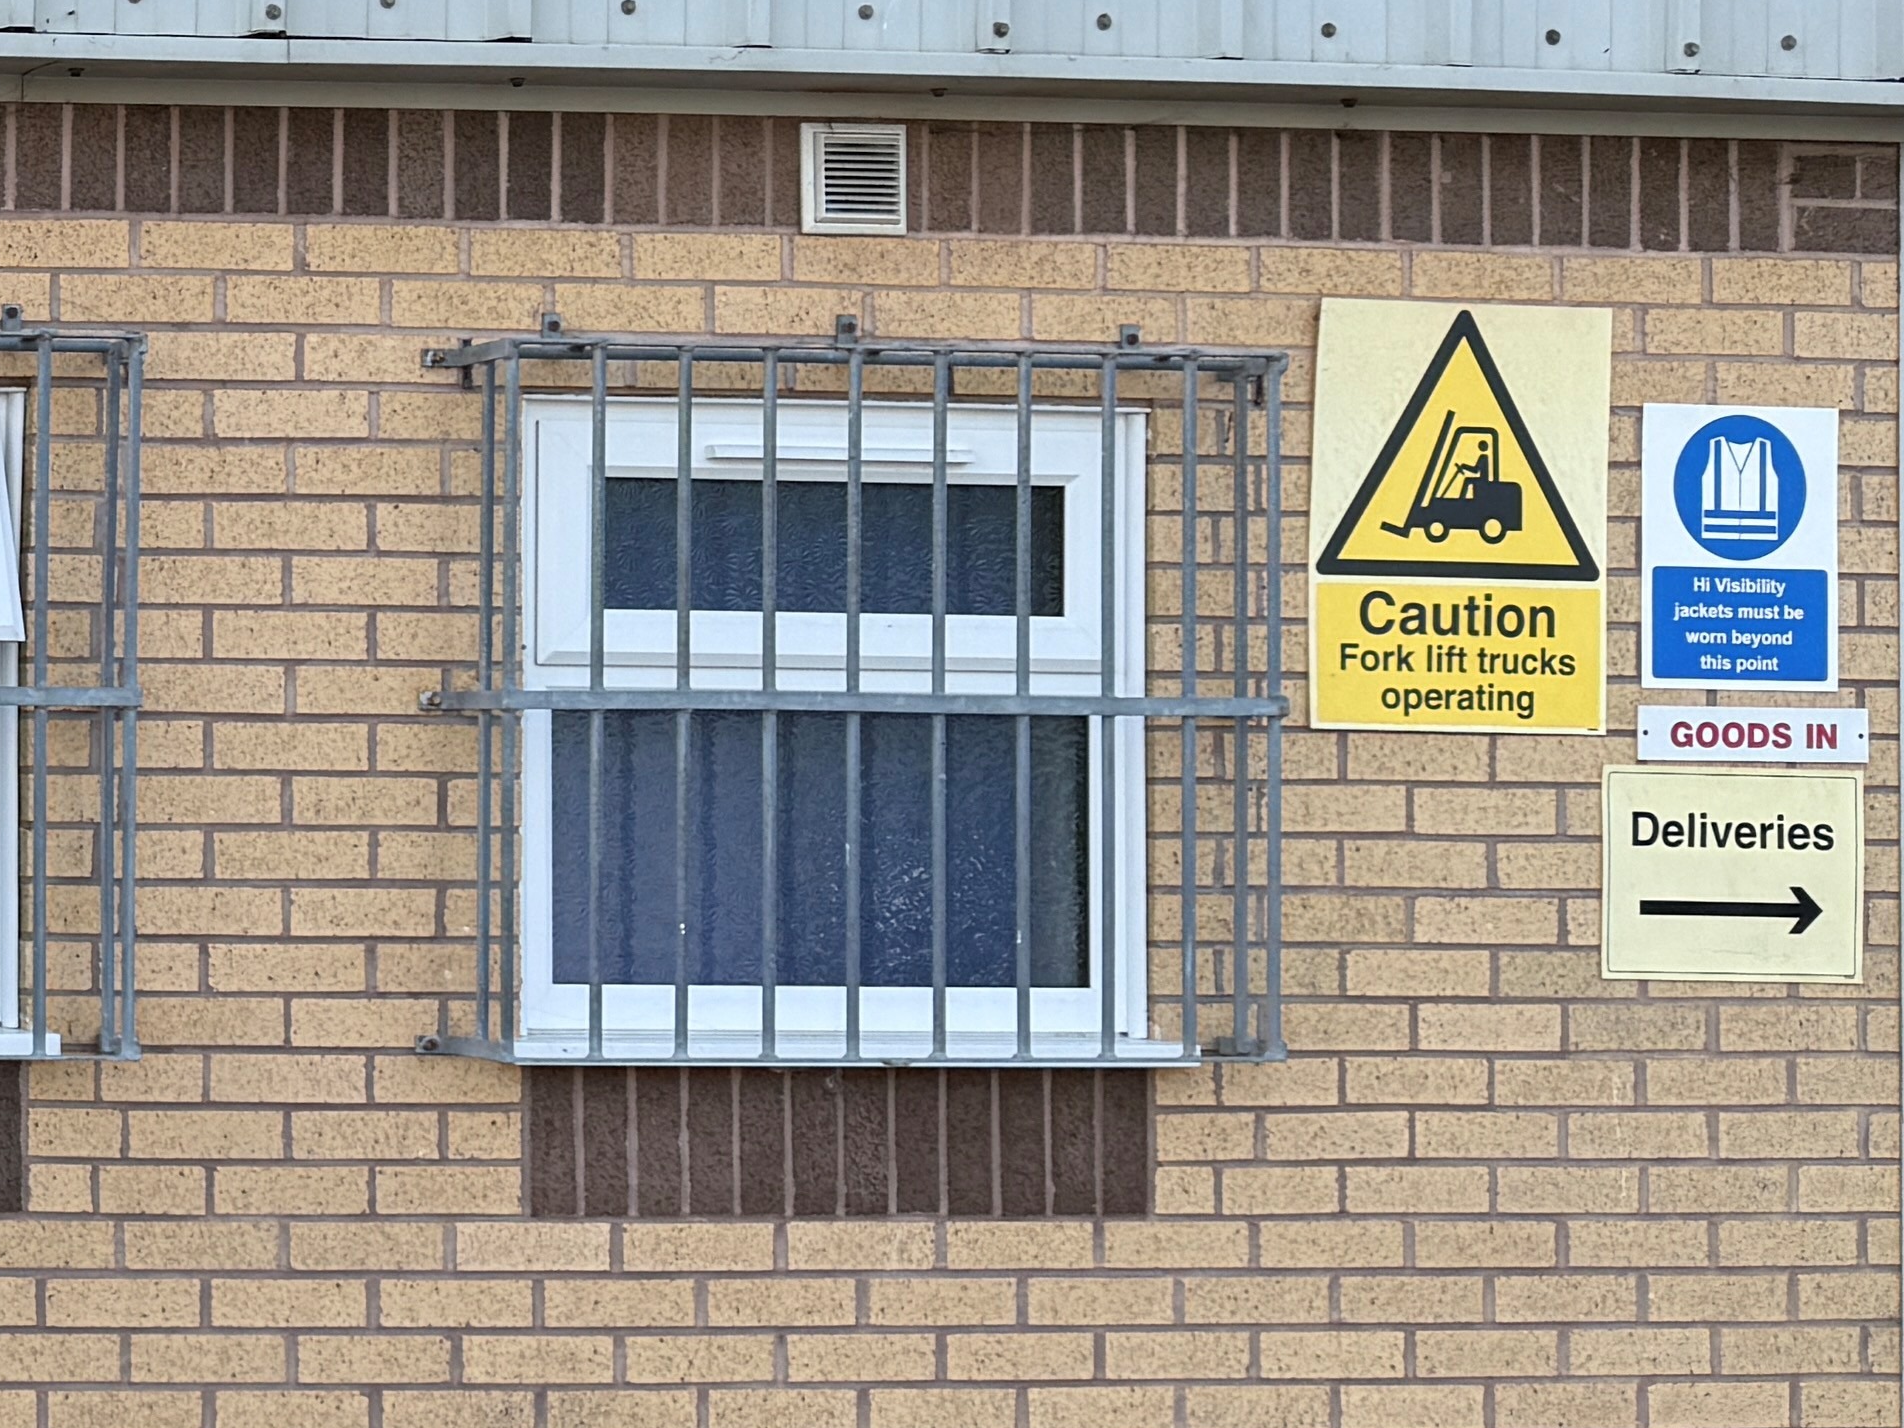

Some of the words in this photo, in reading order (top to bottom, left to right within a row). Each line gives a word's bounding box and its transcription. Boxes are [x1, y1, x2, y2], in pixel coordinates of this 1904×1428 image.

[1693, 577, 1710, 592] Hi
[1715, 577, 1786, 597] Visibility
[1359, 590, 1556, 638] Caution
[1673, 602, 1734, 621] jackets
[1738, 605, 1780, 620] must
[1784, 605, 1804, 620] be
[1686, 631, 1727, 644] worn
[1731, 629, 1793, 649] beyond
[1340, 643, 1415, 672] Fork
[1426, 644, 1468, 673] lift
[1477, 647, 1576, 676] trucks
[1700, 655, 1731, 670] this
[1736, 656, 1779, 673] point
[1381, 683, 1535, 719] operating
[1670, 721, 1793, 749] GOODS
[1806, 723, 1838, 750] IN
[1631, 810, 1835, 851] Deliveries
